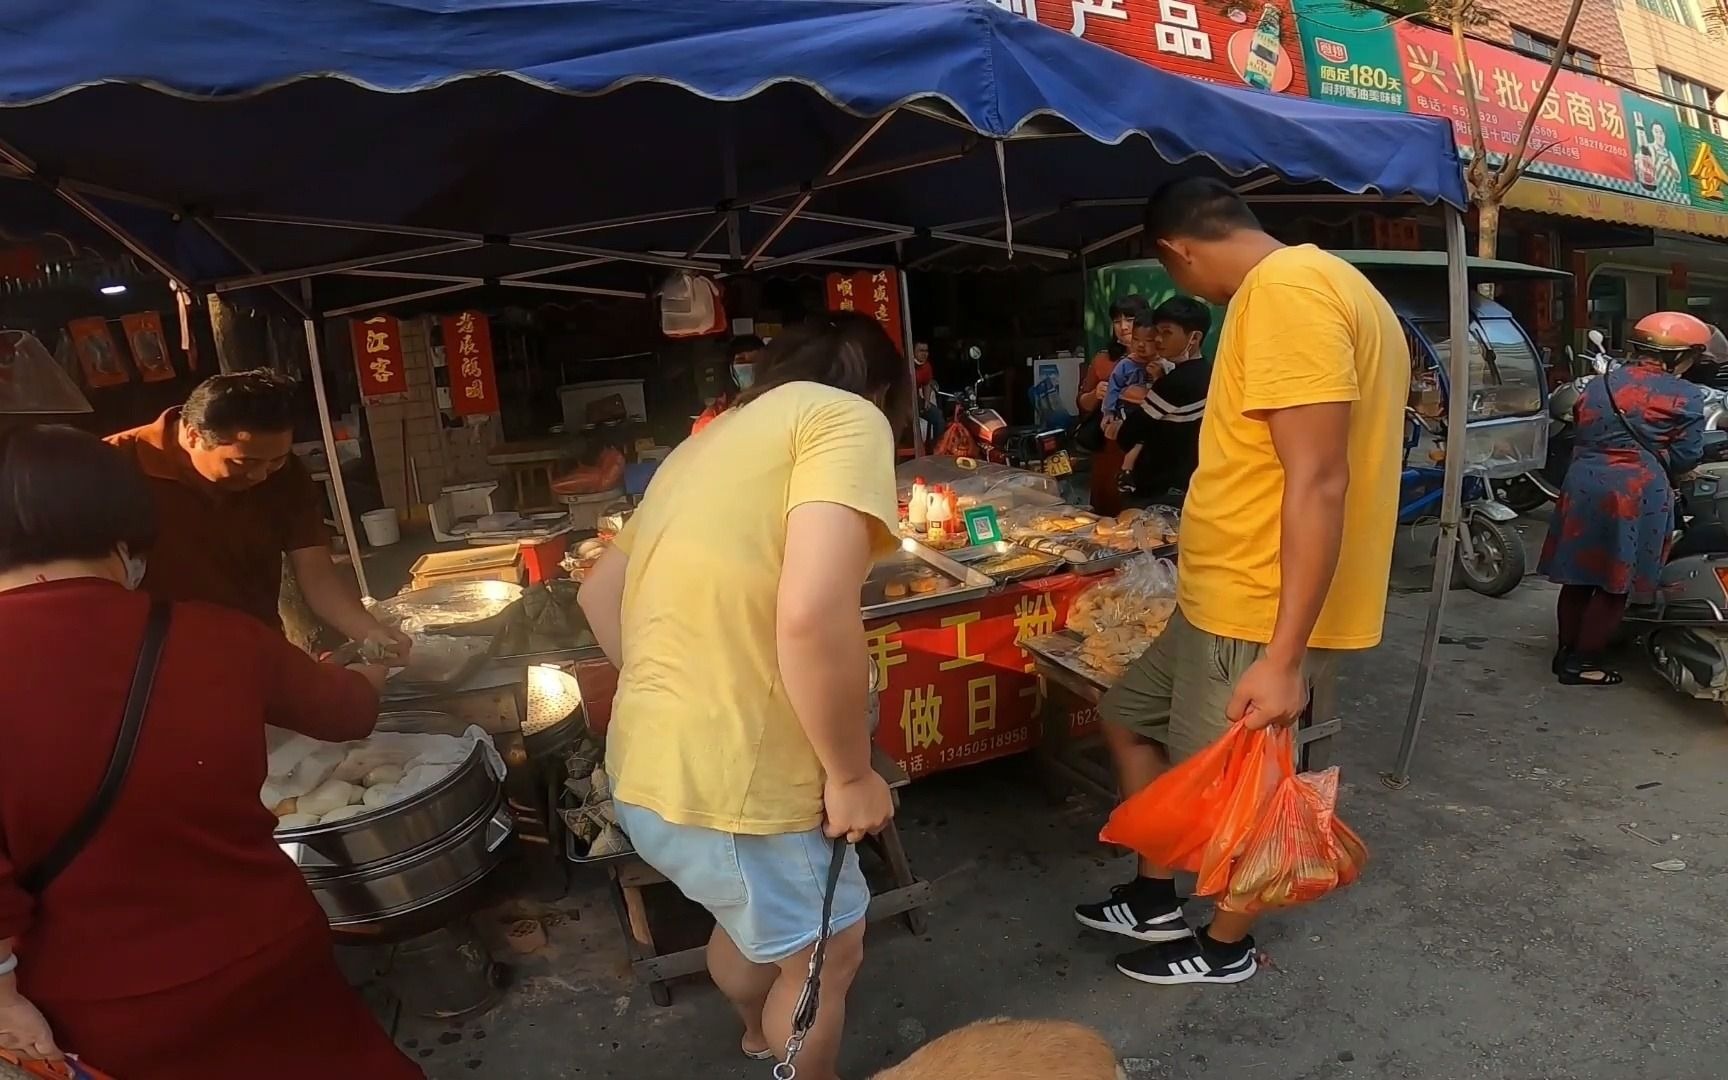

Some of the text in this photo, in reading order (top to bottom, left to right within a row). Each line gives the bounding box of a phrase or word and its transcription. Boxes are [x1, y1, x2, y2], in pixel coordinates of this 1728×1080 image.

[987, 0, 1213, 60] 产品
[1320, 64, 1401, 92] 晒足180天
[1407, 43, 1625, 139] 兴业批发商场
[939, 725, 1029, 764] 13450518958
